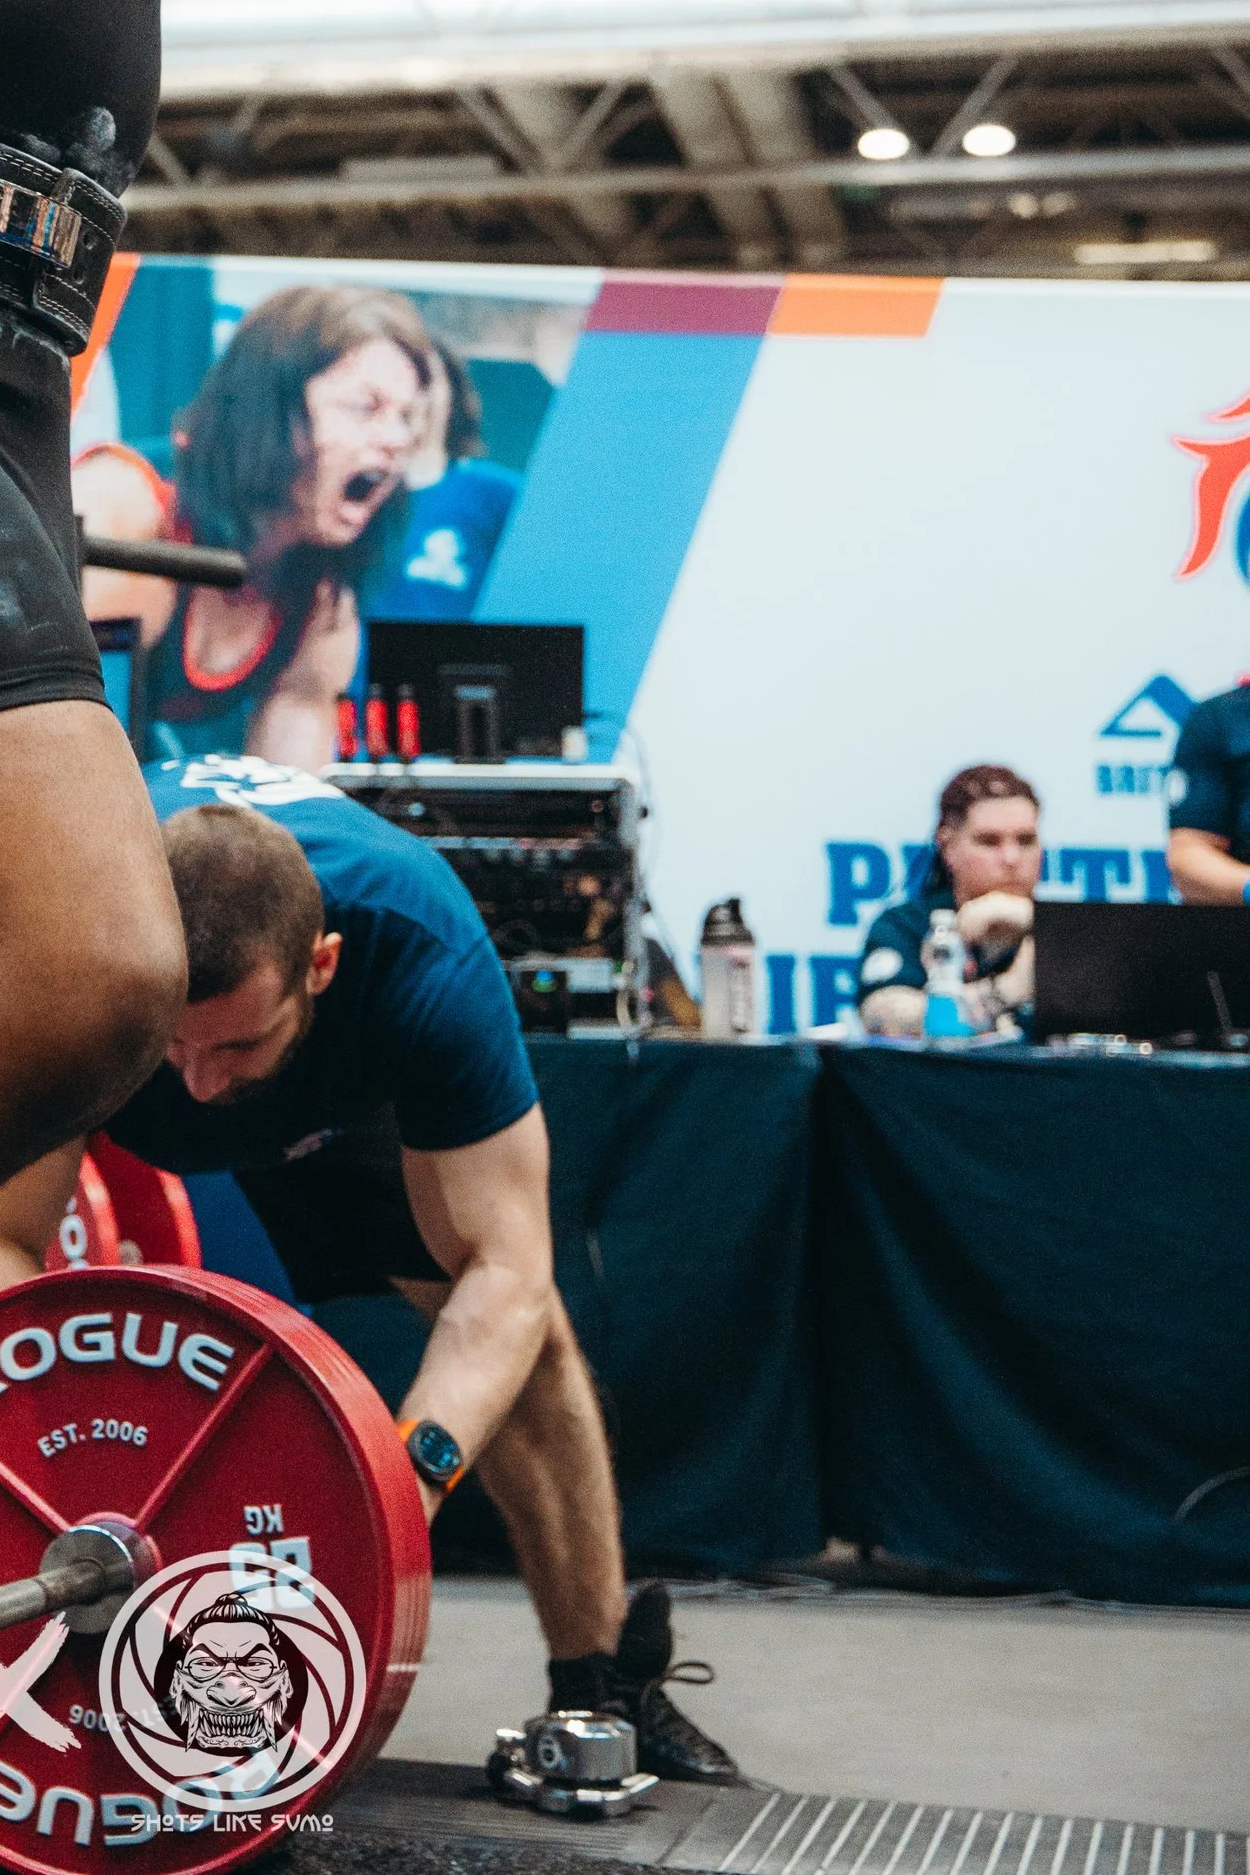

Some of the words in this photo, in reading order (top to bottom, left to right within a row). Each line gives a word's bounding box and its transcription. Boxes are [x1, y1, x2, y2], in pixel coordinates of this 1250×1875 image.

[37, 1422, 87, 1458] EST.
[91, 1418, 149, 1446] 2006
[243, 1504, 284, 1535] KG
